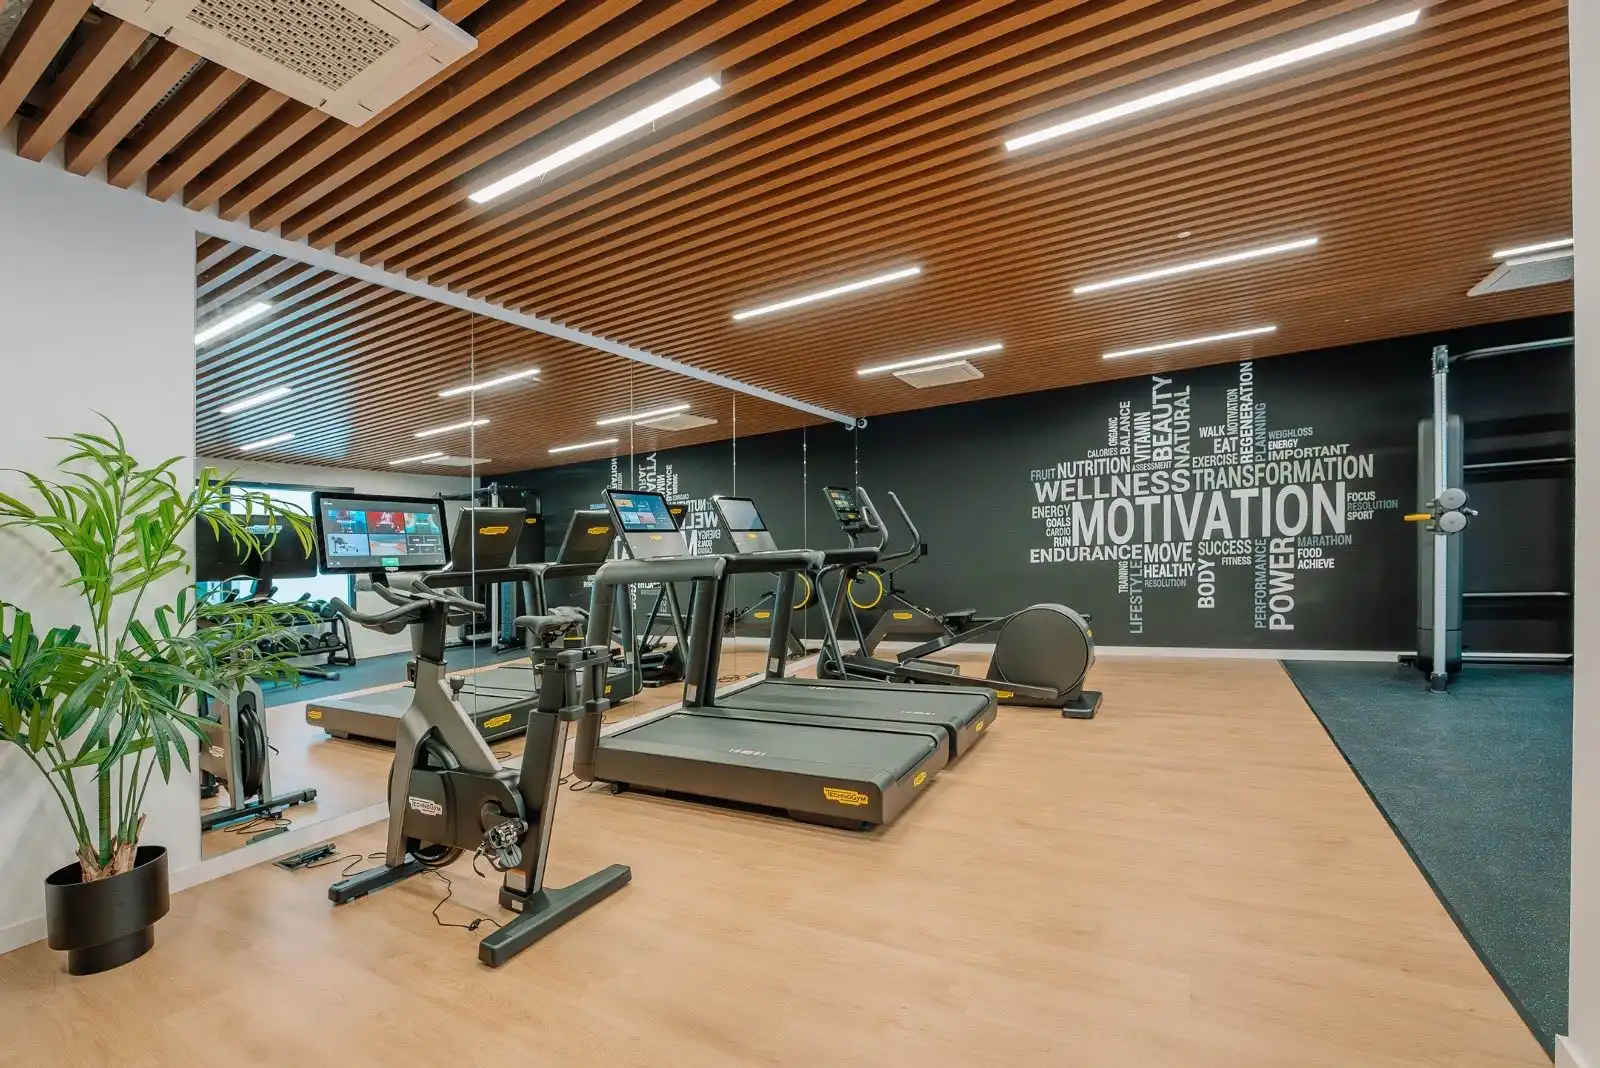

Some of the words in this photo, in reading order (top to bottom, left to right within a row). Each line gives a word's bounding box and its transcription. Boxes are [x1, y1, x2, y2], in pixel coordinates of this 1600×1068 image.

[1152, 376, 1173, 461] BEAUTY
[1226, 388, 1238, 436] MOTIVATION
[1239, 361, 1253, 464] REGENERATION
[1108, 417, 1118, 447] ORGANIC
[1120, 401, 1131, 455] BALANCE
[1174, 385, 1190, 468] NATURAL
[1199, 425, 1225, 438] WALK
[1254, 402, 1267, 462] PLANNING
[1134, 411, 1151, 463] VITAMIN
[1213, 436, 1238, 454] EAT
[1268, 439, 1299, 450] ENERGY
[1087, 447, 1118, 458] CALORIES
[1268, 443, 1350, 461] IMPORTANT
[1057, 456, 1131, 479] NUTRITION
[1132, 461, 1172, 472] ASSESSMENT
[1192, 453, 1238, 469] EXERCISE
[1030, 468, 1056, 481] FRUIT
[1192, 453, 1374, 491] TRANSFORMATION
[1034, 469, 1191, 503] WELLNESS
[1347, 491, 1376, 501] FOCUS
[1032, 504, 1071, 519] ENERGY
[1072, 481, 1346, 547] MOTIVATION
[1347, 500, 1399, 511] RESOLUTION
[1046, 517, 1071, 528] GOALS
[1347, 510, 1375, 521] SPORT
[1046, 527, 1071, 537] CARDIO
[1297, 534, 1352, 547] MARATHON
[1053, 536, 1071, 547] RUN
[1198, 539, 1252, 556] SUCCESS
[1030, 544, 1143, 563] ENDURANCE
[1144, 542, 1193, 563] MOVE
[1221, 556, 1252, 566] FITNESS
[1297, 547, 1322, 559] FOOD
[1144, 563, 1195, 578] HEALTHY
[1297, 558, 1335, 570] ACHIEVE
[1119, 560, 1129, 594] TRAINING
[1144, 578, 1187, 588] RESOLUTION
[1197, 558, 1215, 609] BODY
[1254, 538, 1267, 629] PERFORMANCE
[1269, 537, 1295, 630] POWER
[1130, 560, 1143, 634] LIFESTYLE
[825, 789, 867, 802] TECHNOGYM
